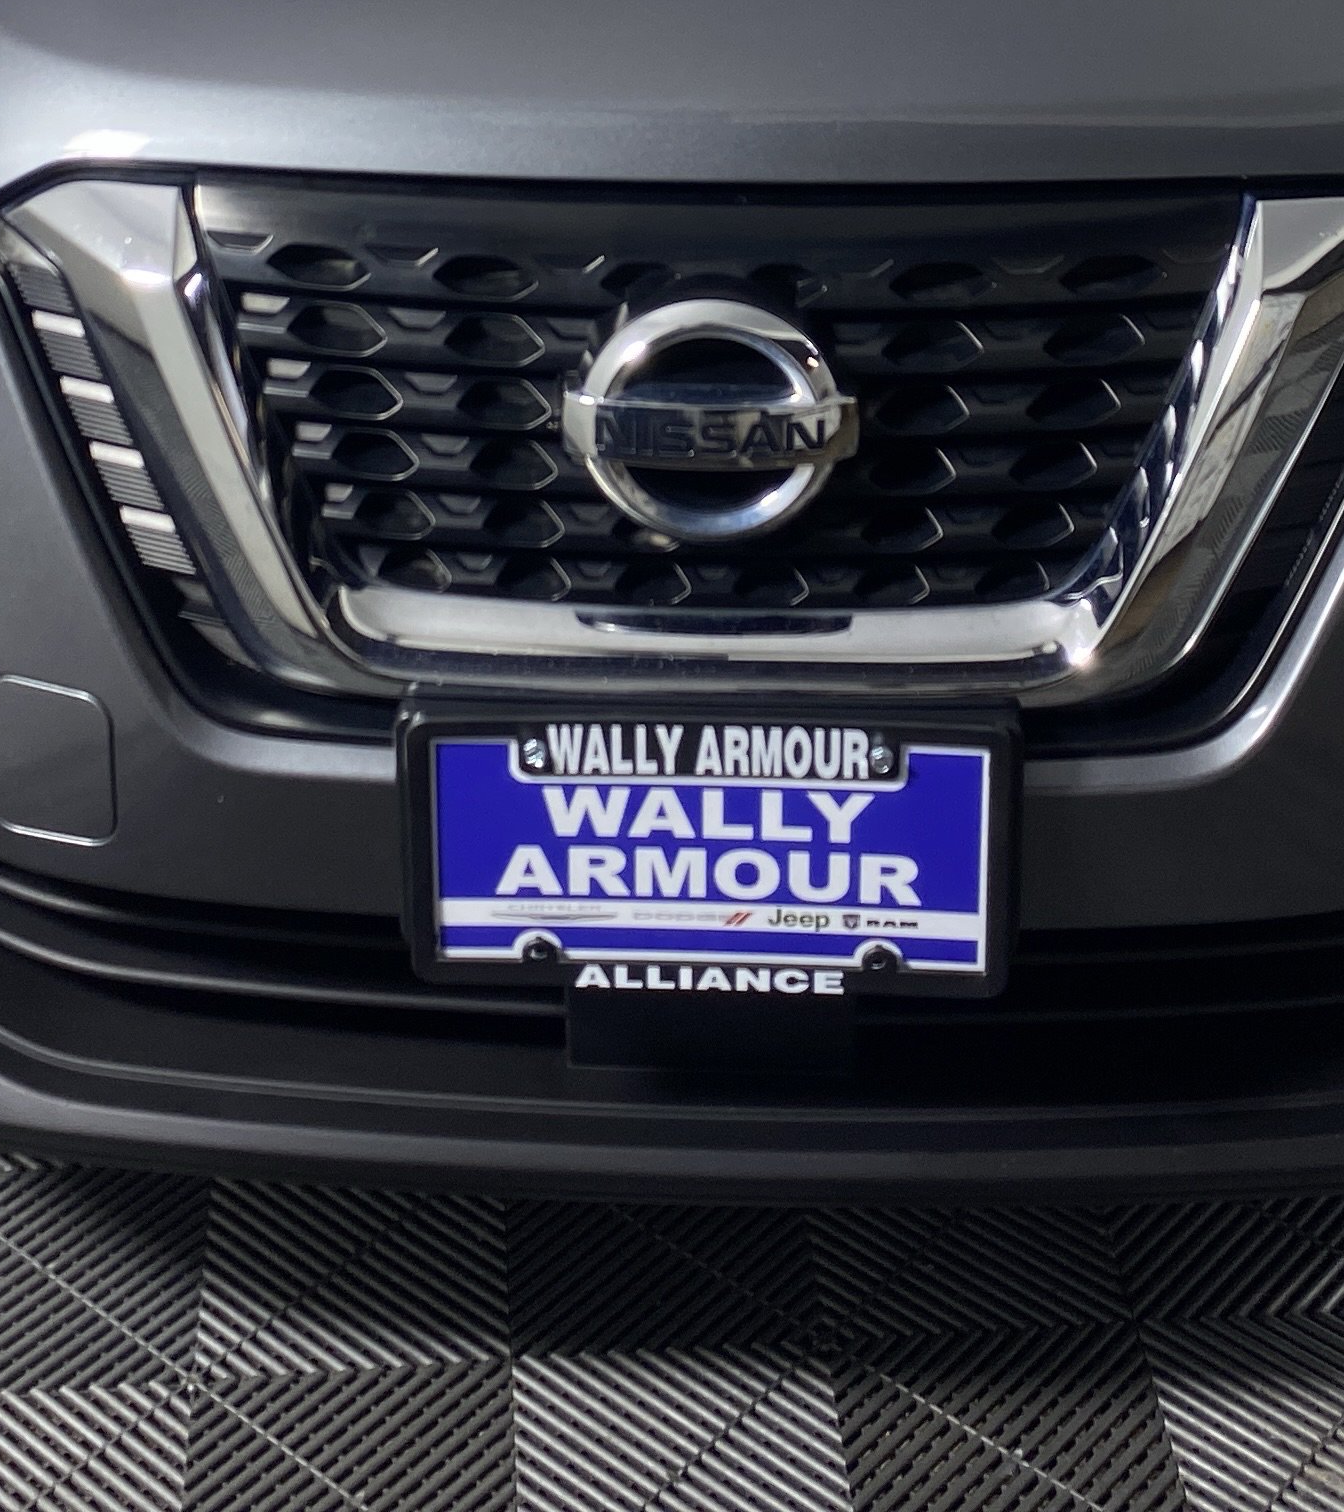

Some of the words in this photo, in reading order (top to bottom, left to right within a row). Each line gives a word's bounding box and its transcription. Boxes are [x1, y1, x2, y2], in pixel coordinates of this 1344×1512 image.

[596, 411, 826, 457] NISSAN
[547, 723, 684, 776] WALLY
[695, 724, 870, 780] ARMOUR
[541, 786, 875, 844] WALLY
[495, 844, 922, 906] ARMOUR
[768, 906, 831, 932] Jeep
[866, 919, 919, 930] RAM
[575, 963, 845, 996] ALLIANCE
